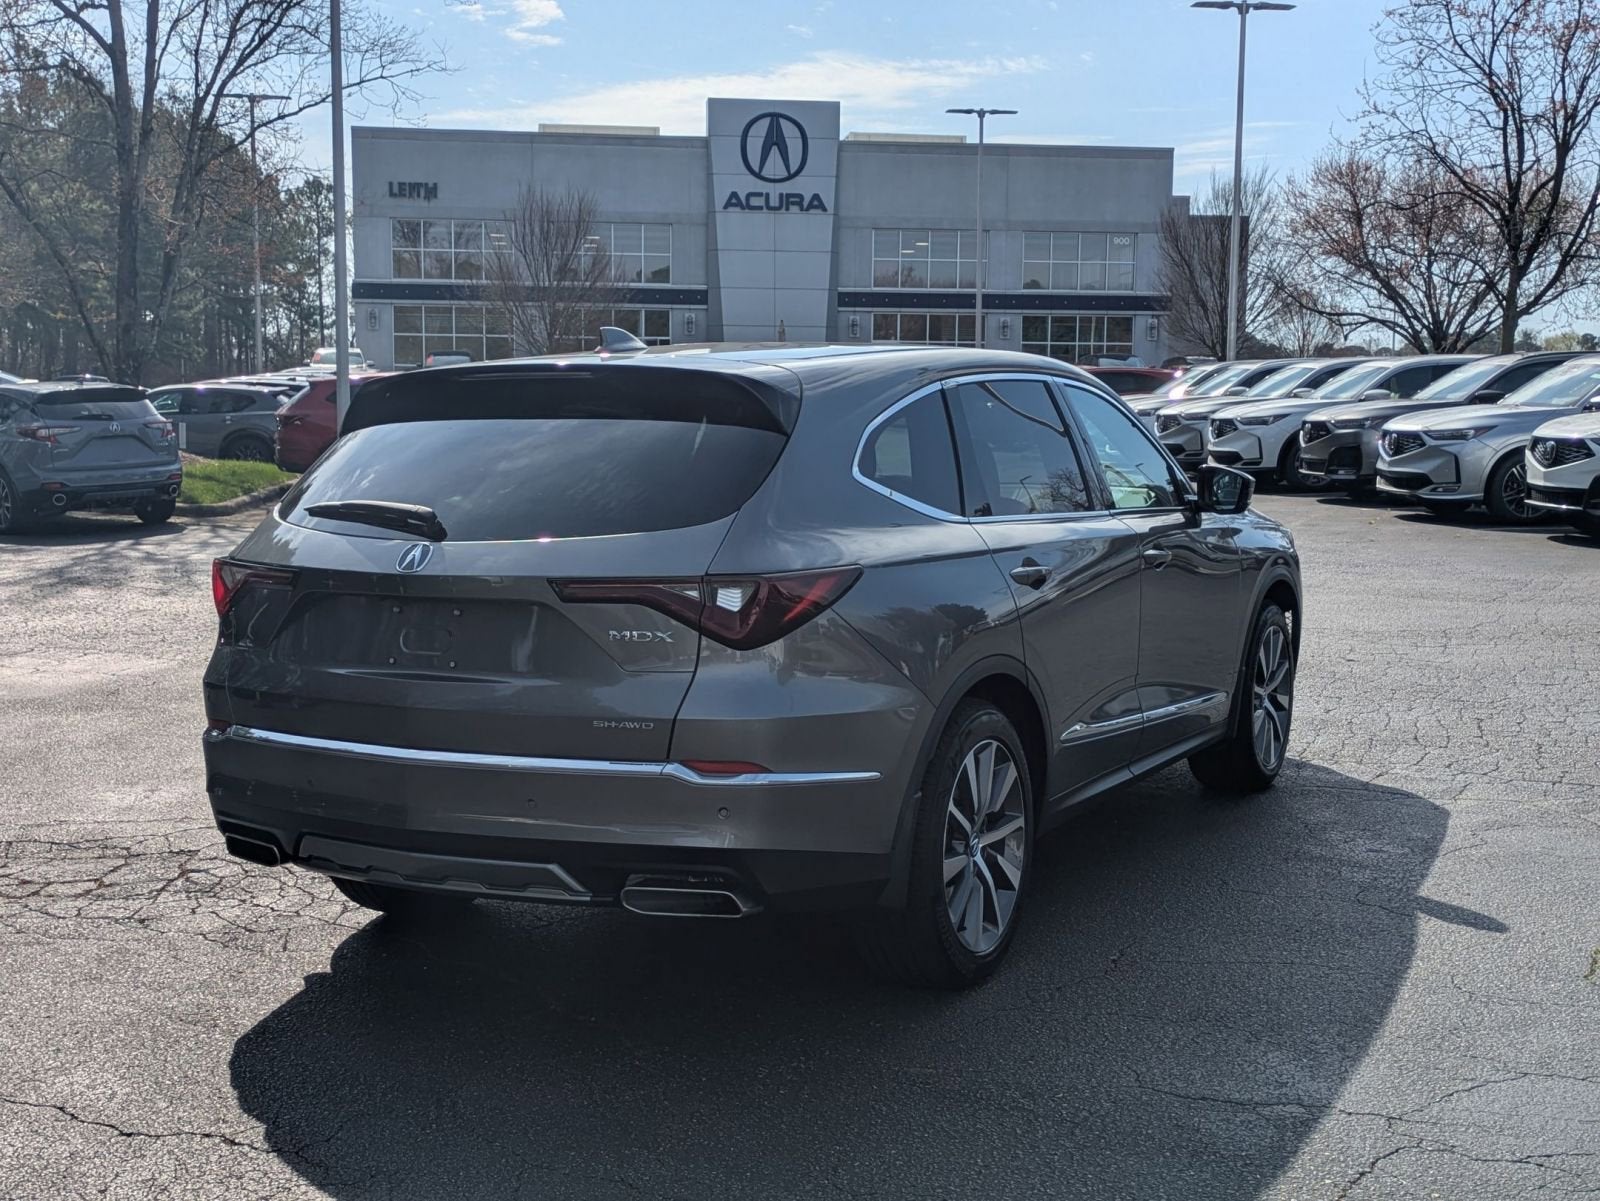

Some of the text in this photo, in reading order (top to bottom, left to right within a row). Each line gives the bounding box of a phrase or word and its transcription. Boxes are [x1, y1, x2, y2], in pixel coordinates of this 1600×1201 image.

[722, 191, 828, 212] ACURA
[1113, 237, 1130, 245] 900
[608, 630, 674, 642] MDX
[592, 720, 654, 729] SH-AWD
